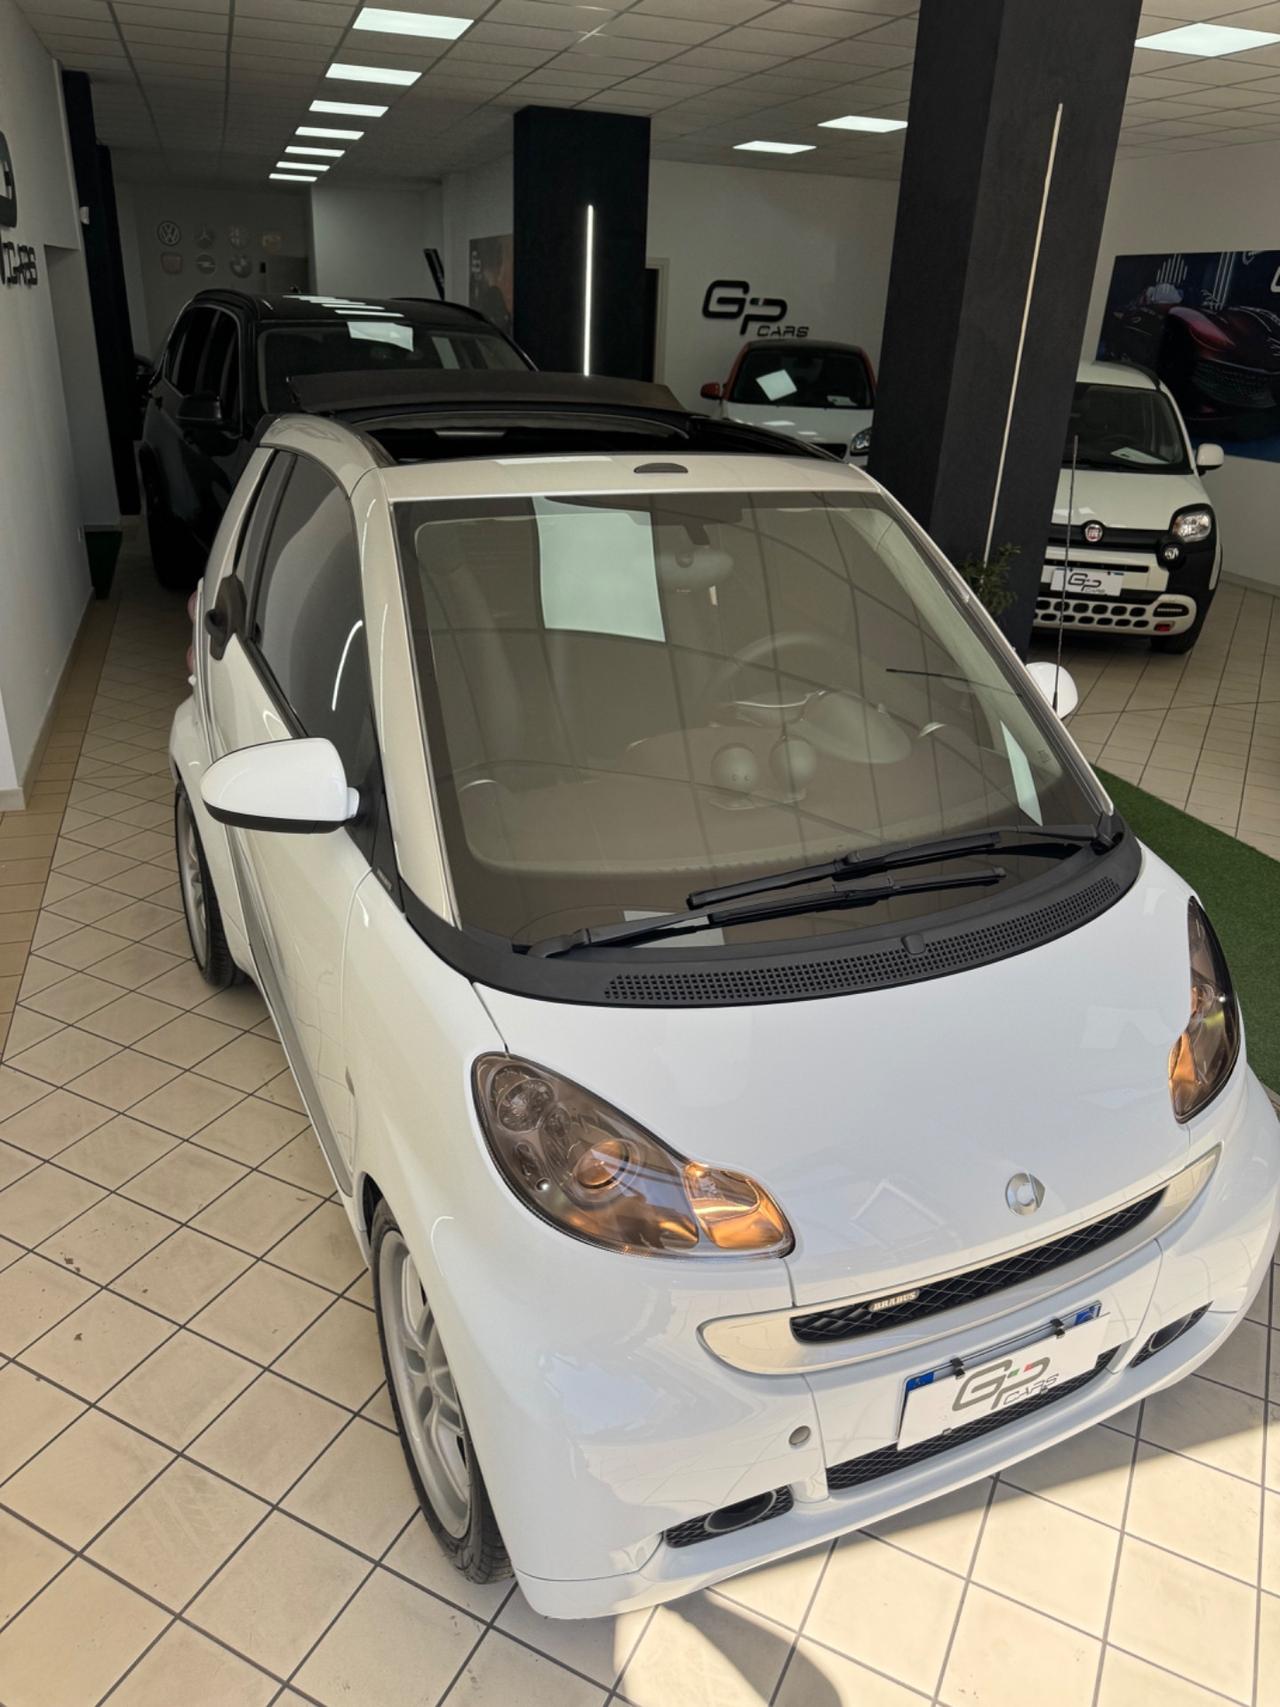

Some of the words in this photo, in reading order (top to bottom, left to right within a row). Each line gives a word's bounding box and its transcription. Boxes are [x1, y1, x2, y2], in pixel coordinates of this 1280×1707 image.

[702, 279, 787, 336] GP
[757, 325, 810, 338] CARS
[1068, 572, 1102, 592] GP
[952, 1357, 1051, 1411] GP
